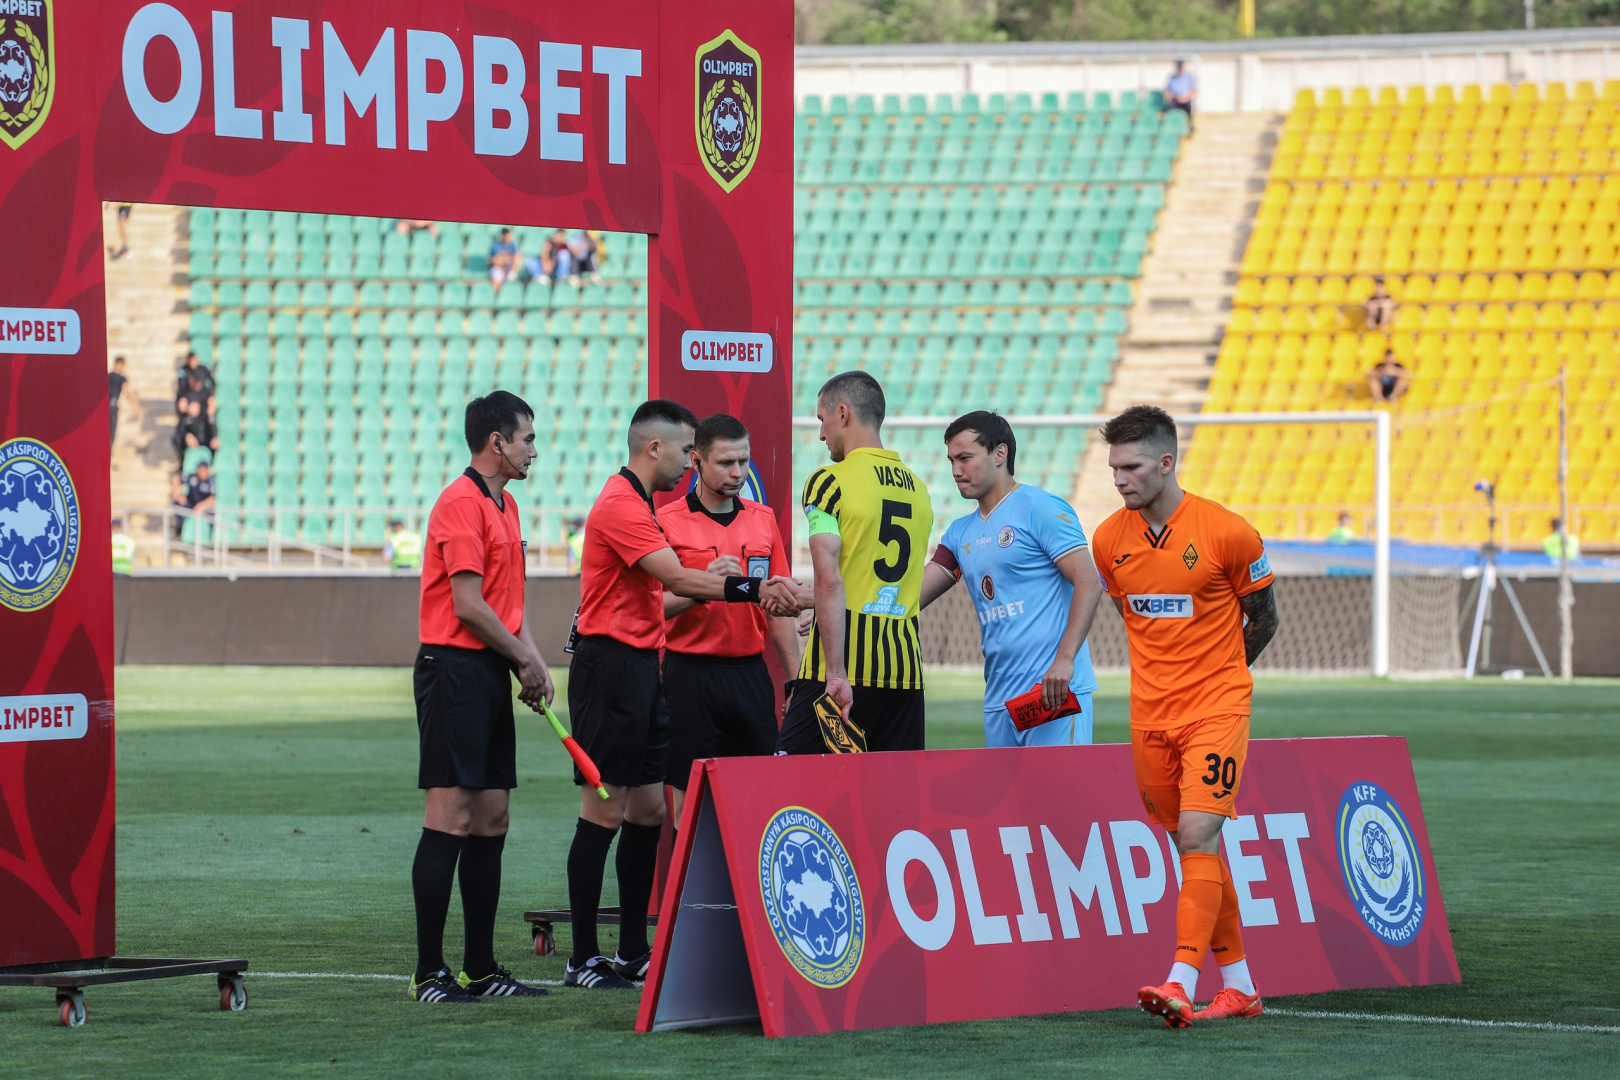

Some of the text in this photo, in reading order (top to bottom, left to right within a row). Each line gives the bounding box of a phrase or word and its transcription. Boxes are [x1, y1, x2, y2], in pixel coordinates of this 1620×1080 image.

[122, 2, 643, 166] OLIMPBET
[703, 59, 754, 77] OLIMPBET
[690, 340, 763, 362] OLIMPBET
[873, 465, 916, 493] VASIN
[68, 505, 78, 554] LIGASY
[873, 498, 913, 583] 5
[1132, 598, 1187, 614] 1XBET
[0, 706, 75, 730] IMPBET
[1202, 752, 1237, 790] 30
[1352, 785, 1377, 803] KFF
[847, 874, 863, 926] LIGASY
[885, 812, 1316, 951] OLIMPET
[1361, 901, 1423, 942] KAZAKHSTAN
